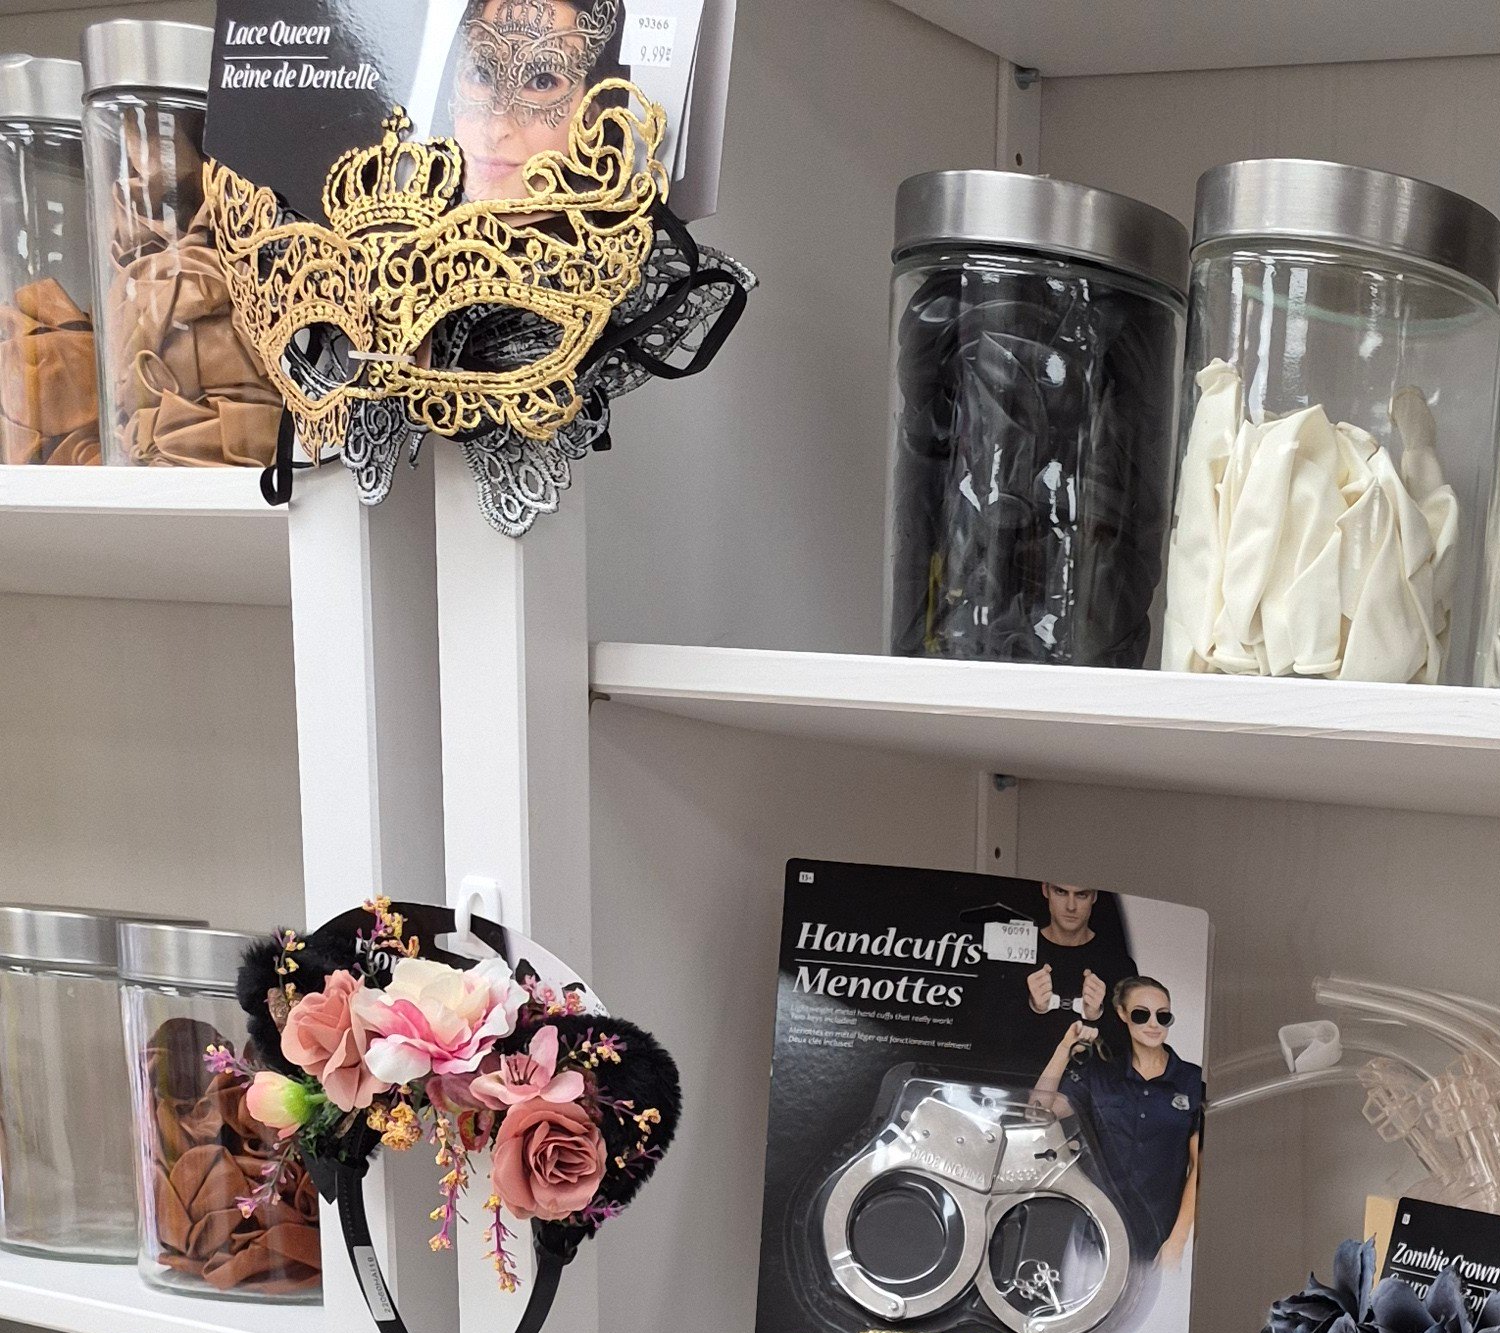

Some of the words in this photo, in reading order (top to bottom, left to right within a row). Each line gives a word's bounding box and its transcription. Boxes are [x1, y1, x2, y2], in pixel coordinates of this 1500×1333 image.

[225, 20, 268, 45] Lace
[269, 20, 331, 46] Queen
[639, 17, 669, 30] 93366
[221, 63, 272, 89] Reine
[273, 61, 296, 88] de
[298, 63, 380, 90] Dentelle
[795, 921, 983, 968] Handcuffs
[792, 966, 964, 1008] Menottes
[1391, 1241, 1450, 1273] Zombie
